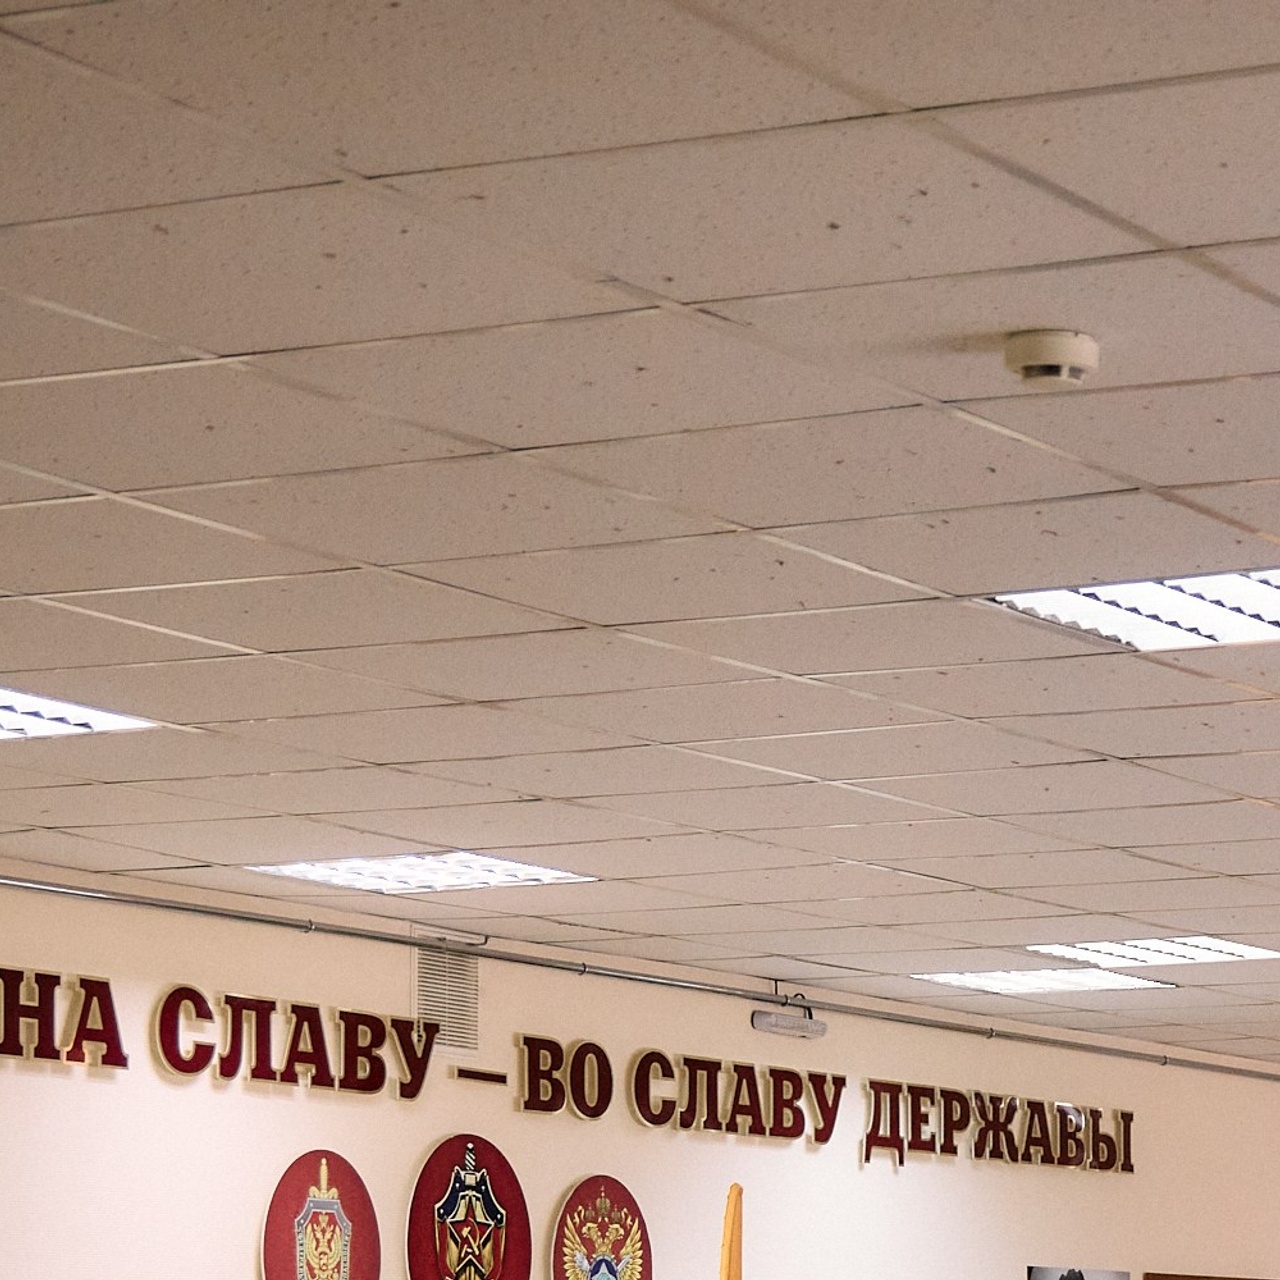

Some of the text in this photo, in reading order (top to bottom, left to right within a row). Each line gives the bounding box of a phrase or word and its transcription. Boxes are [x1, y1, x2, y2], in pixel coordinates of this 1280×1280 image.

[0, 967, 129, 1069] НА
[158, 985, 441, 1099] СЛАВУ
[522, 1035, 614, 1119] ВО
[634, 1050, 847, 1144] СЛАВУ
[864, 1079, 1135, 1173] ДЕРЖАВЫ
